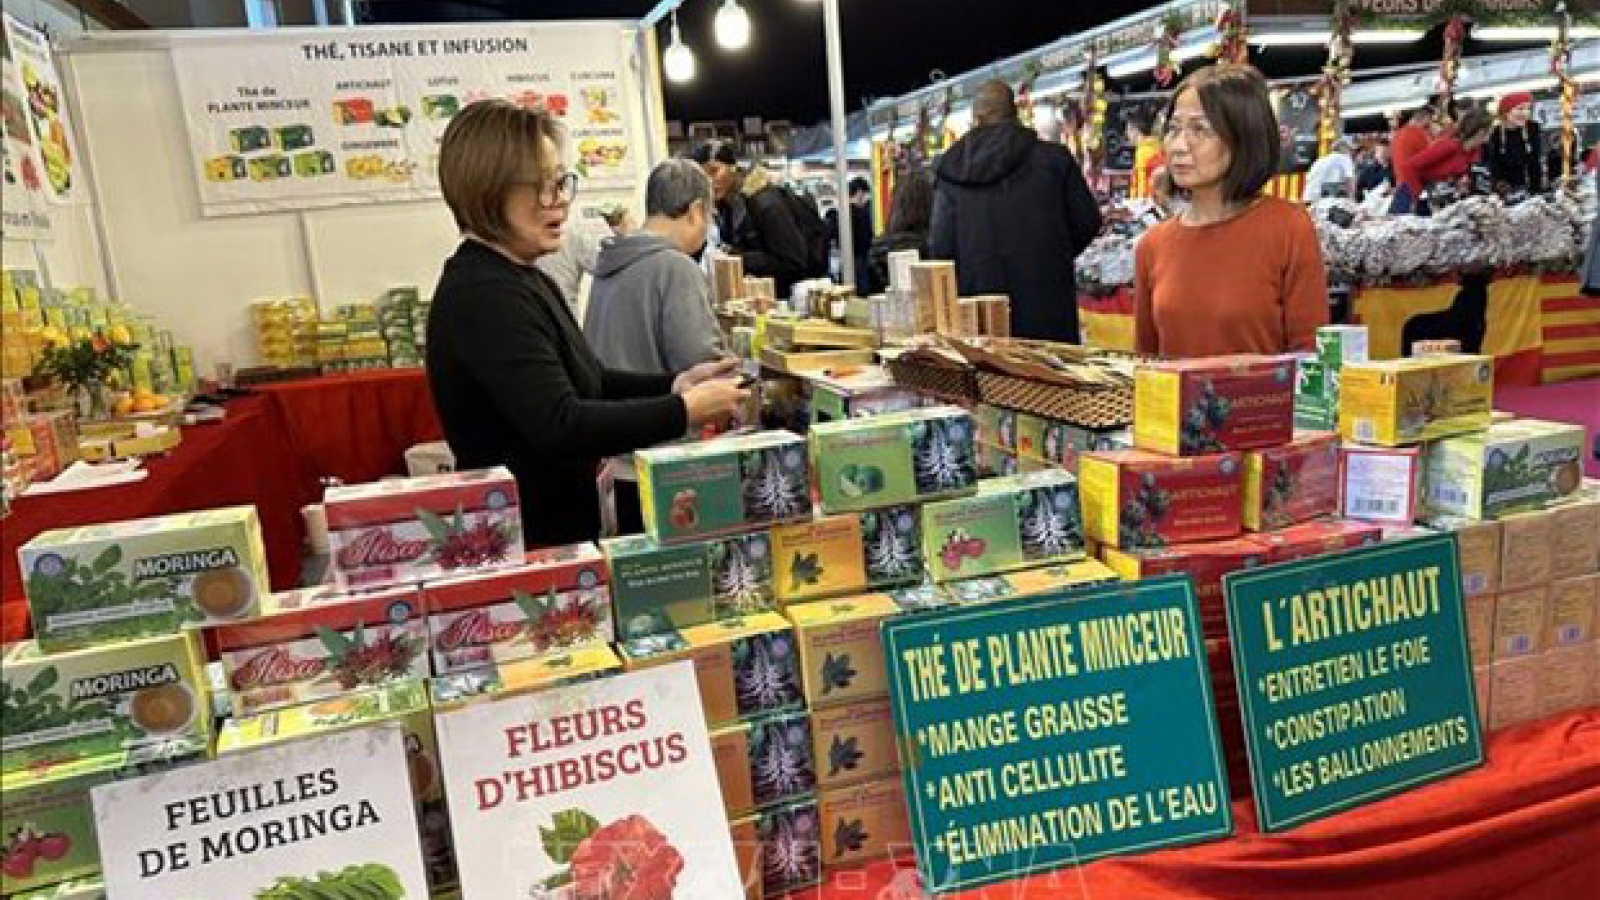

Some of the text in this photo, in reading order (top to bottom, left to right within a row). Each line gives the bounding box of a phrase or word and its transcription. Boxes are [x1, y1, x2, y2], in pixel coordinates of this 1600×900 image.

[349, 41, 413, 59] TISANE
[418, 40, 437, 56] ET
[444, 37, 527, 54] INFUSION
[134, 548, 237, 578] MORINGA
[71, 664, 178, 698] MORINGA
[903, 607, 1190, 702] THÉ DE PLANTE MINCEUR
[1367, 646, 1389, 676] LE
[1393, 636, 1431, 670] FOIE
[504, 699, 647, 758] FLEURS
[1024, 693, 1129, 740] GRAISSE
[474, 732, 688, 811] D'HIBISCUS
[1001, 745, 1127, 798] CELLULITE
[1318, 716, 1469, 785] BALLONNEMENTS
[165, 768, 340, 831] FEUILLES
[1109, 795, 1142, 831] DE
[1147, 781, 1217, 825] L'EAU
[137, 800, 381, 879] DE MORINGA
